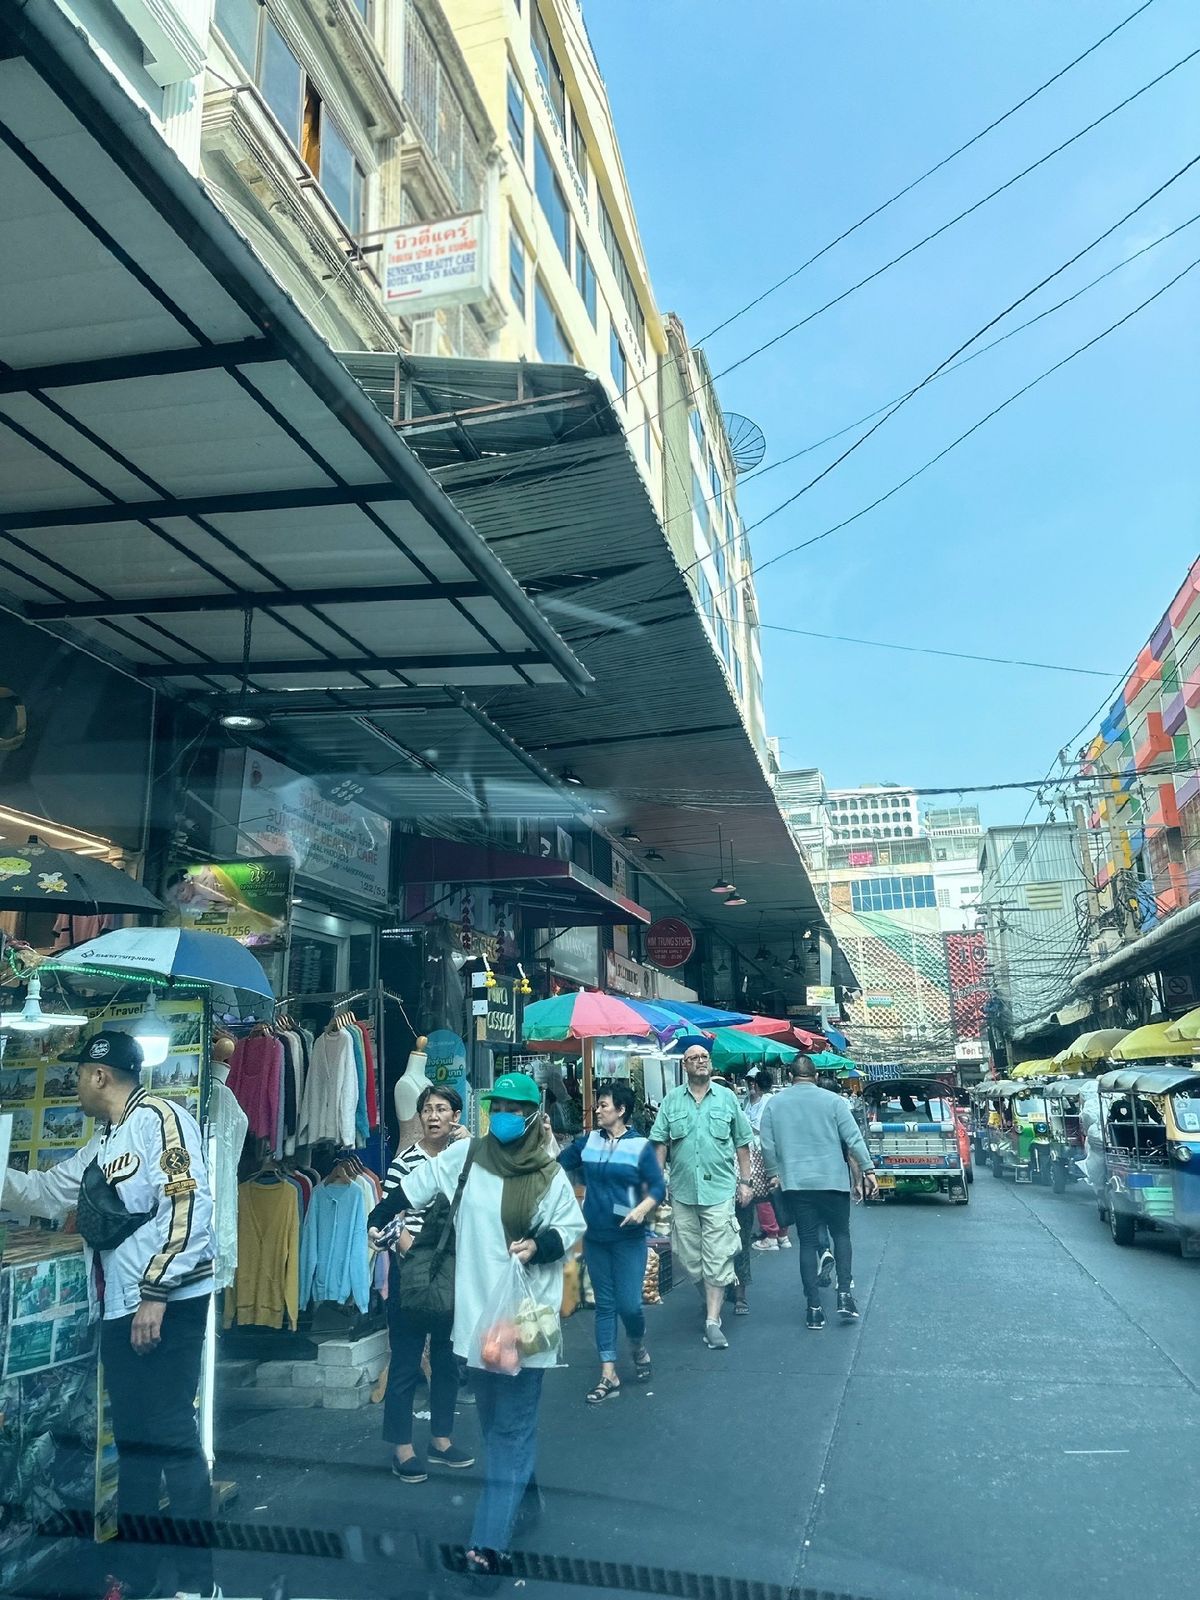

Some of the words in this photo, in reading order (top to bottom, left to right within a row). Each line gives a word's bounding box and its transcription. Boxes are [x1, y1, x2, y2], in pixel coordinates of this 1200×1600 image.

[425, 257, 454, 271] BEAUTY
[456, 252, 476, 266] CARE
[387, 276, 409, 288] HOTEL
[675, 937, 691, 946] STORE
